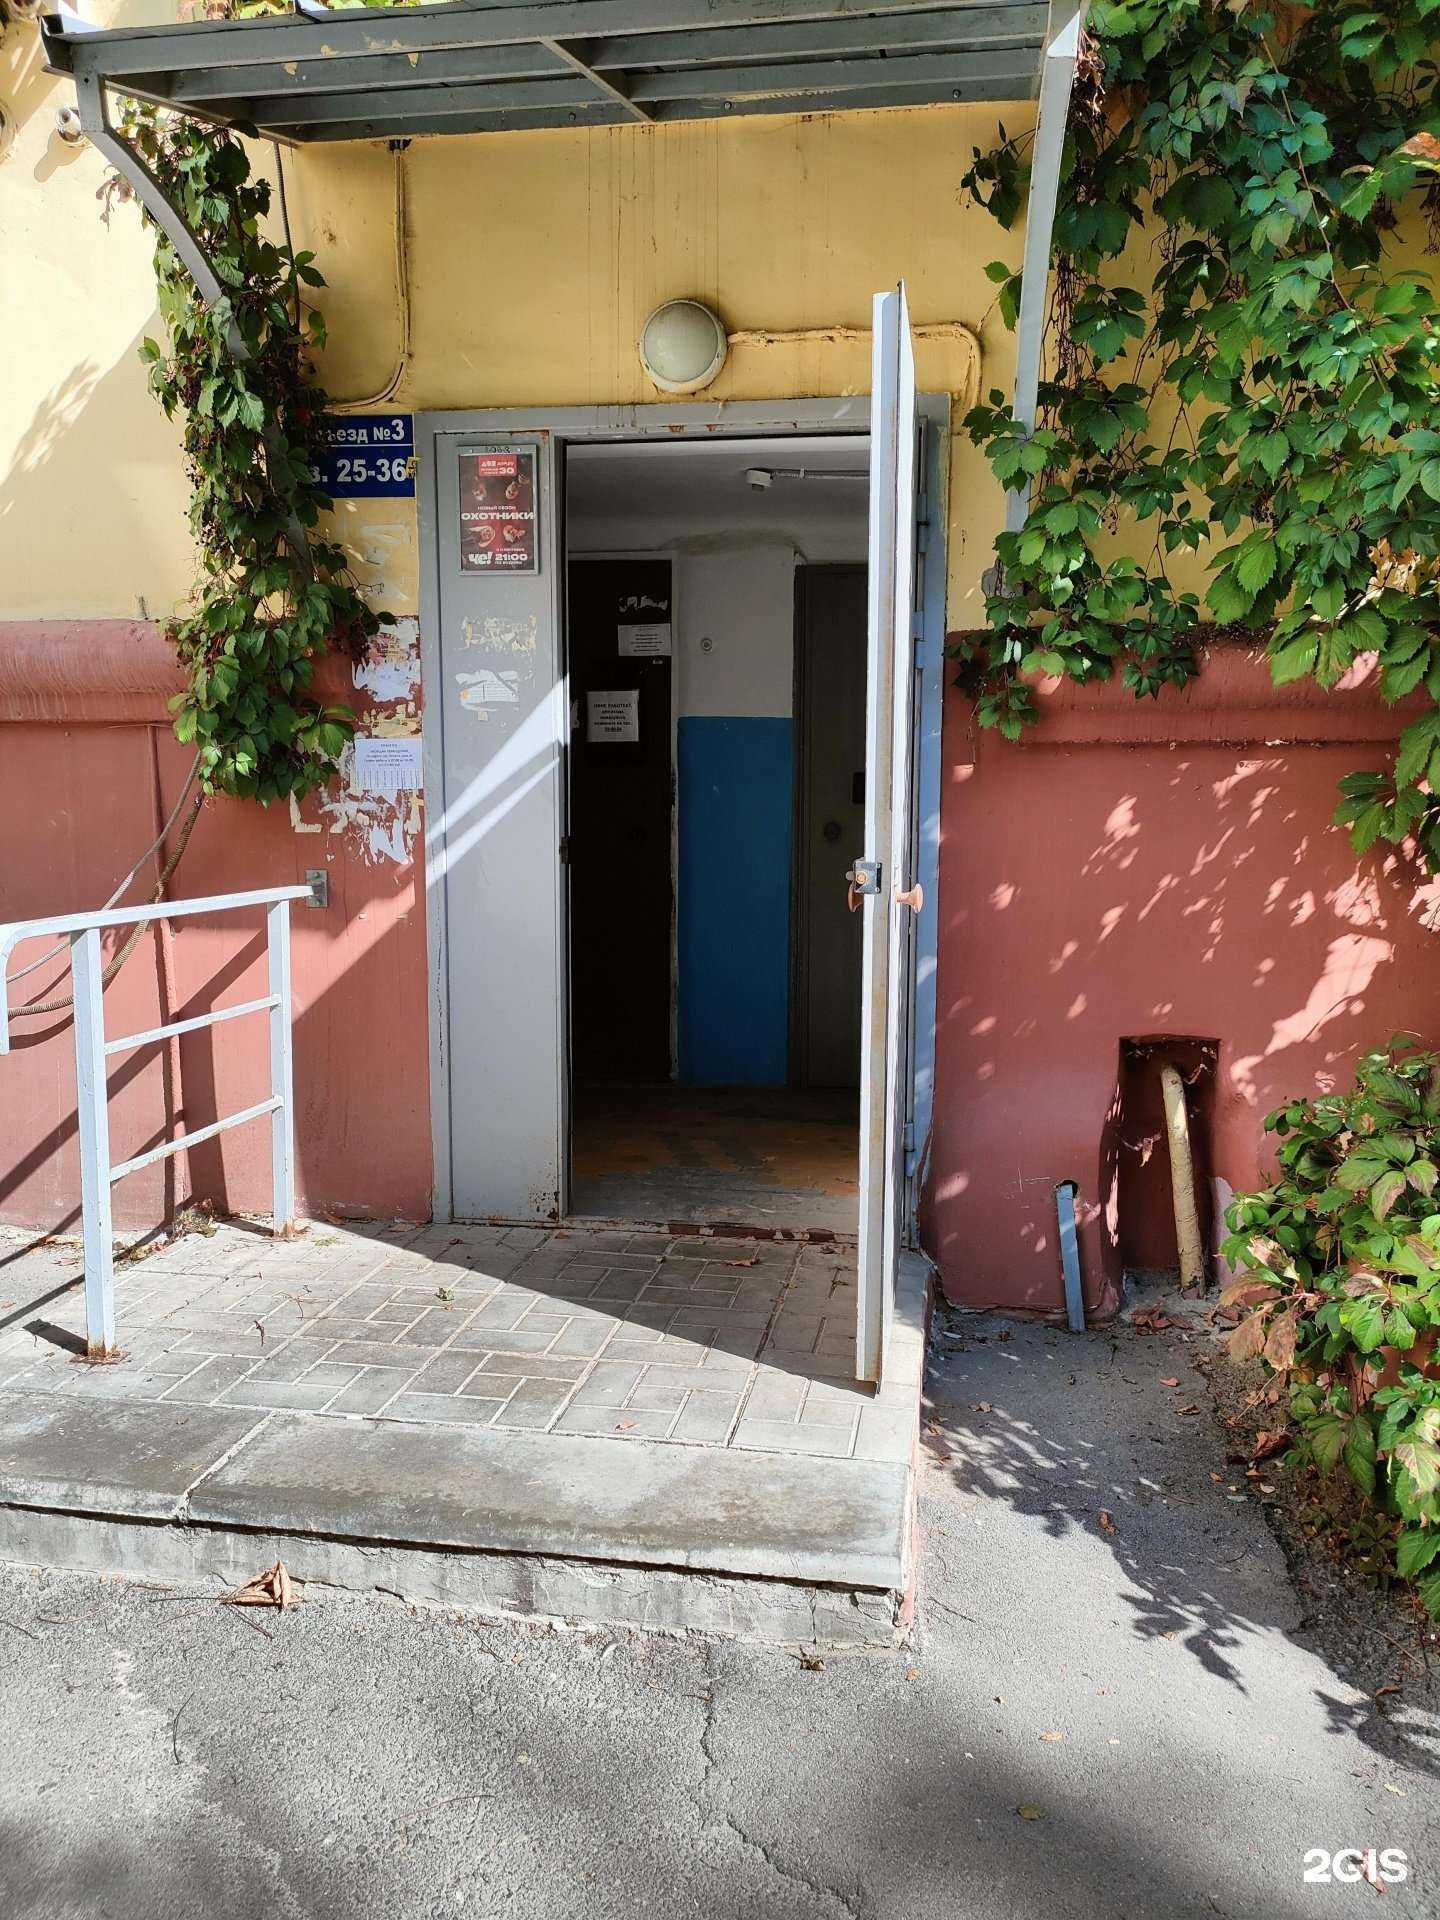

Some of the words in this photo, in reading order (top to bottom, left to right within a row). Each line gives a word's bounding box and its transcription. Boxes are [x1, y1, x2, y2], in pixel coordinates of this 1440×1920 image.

[373, 419, 405, 441] №3
[336, 458, 406, 482] 25-36
[461, 511, 535, 520] ОХОТНИКИ
[495, 553, 528, 561] 21:00
